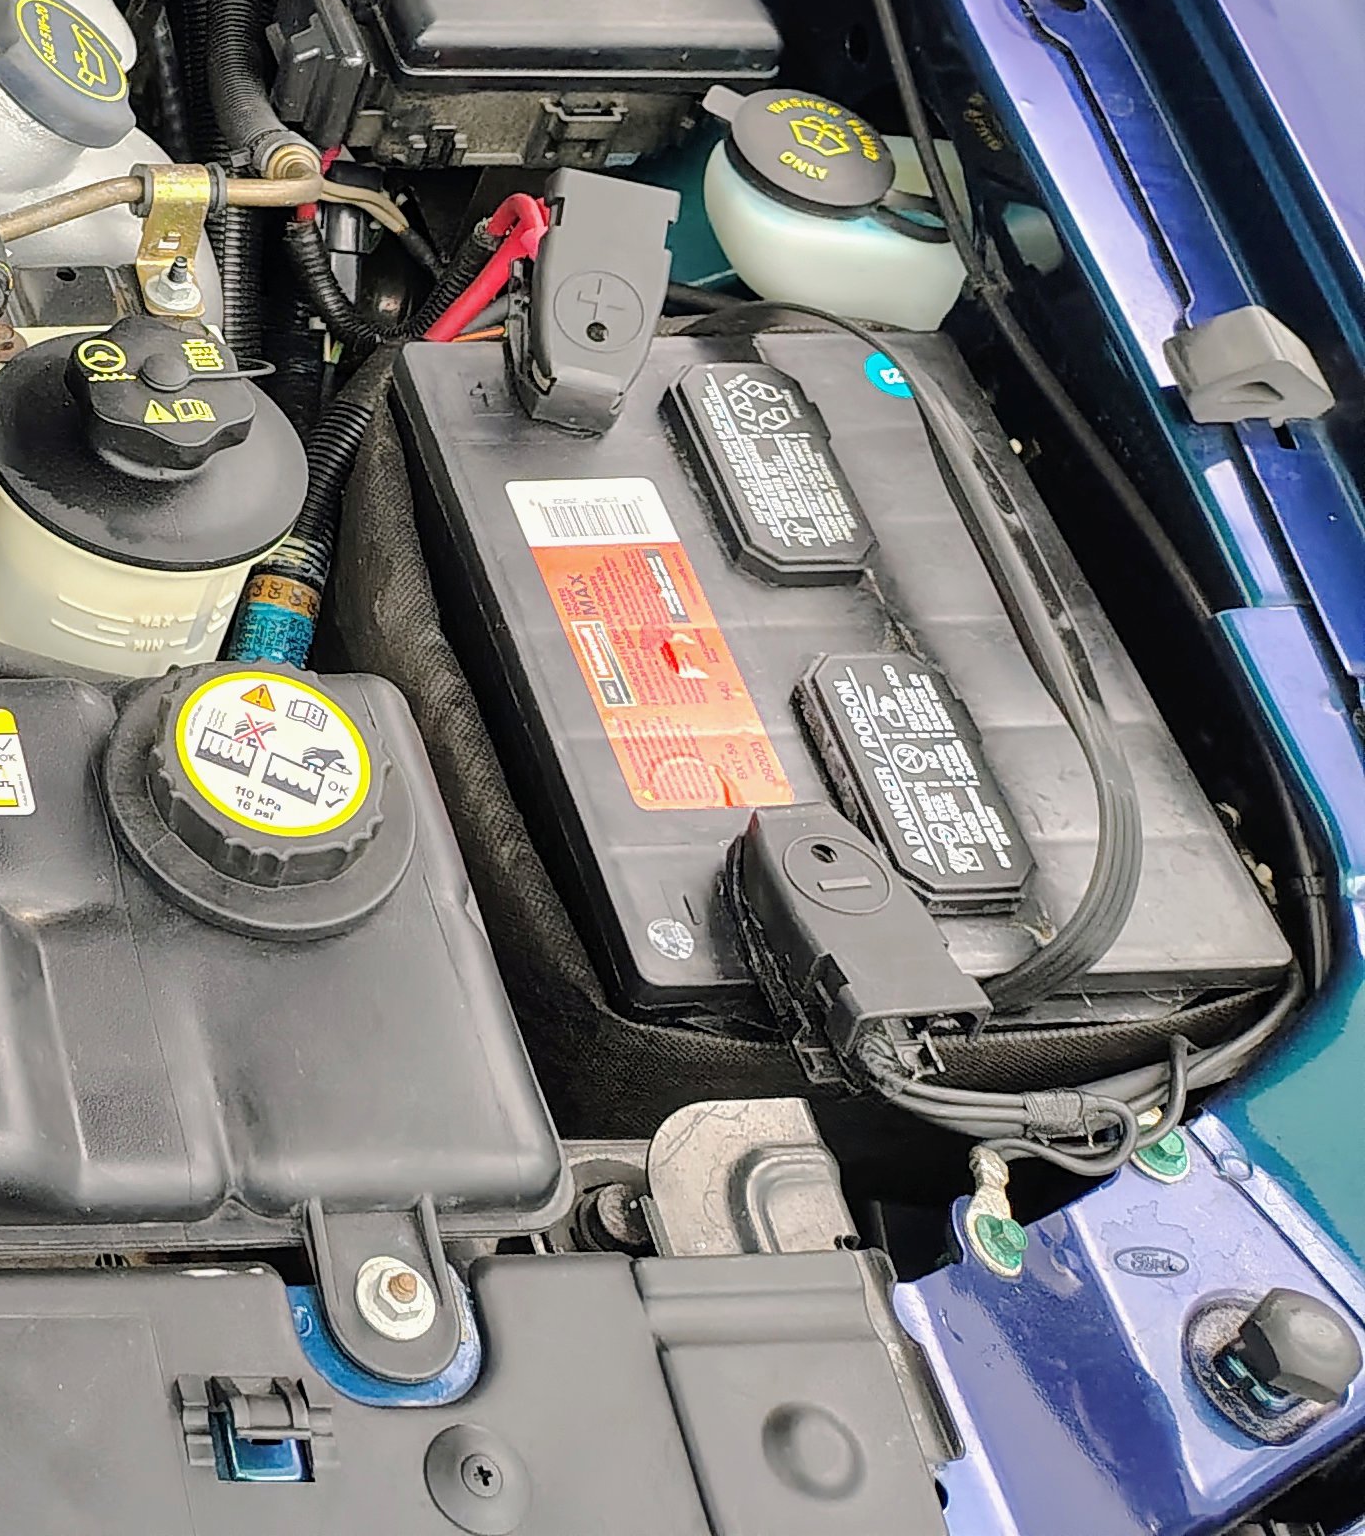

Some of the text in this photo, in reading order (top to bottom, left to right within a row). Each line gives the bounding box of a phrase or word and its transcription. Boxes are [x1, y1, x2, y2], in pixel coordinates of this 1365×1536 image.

[766, 97, 842, 117] WASHER
[779, 151, 829, 180] ONLY
[567, 574, 598, 615] MAX
[139, 615, 175, 628] MAX
[132, 639, 166, 652] MIN
[717, 681, 733, 701] 540
[834, 680, 879, 747] POISON
[0, 753, 18, 762] OK
[750, 741, 775, 782] 092023
[924, 751, 941, 768] NO
[327, 780, 350, 796] OK
[235, 785, 282, 812] 110 kPa
[873, 767, 924, 845] DANGER
[253, 808, 275, 821] psi
